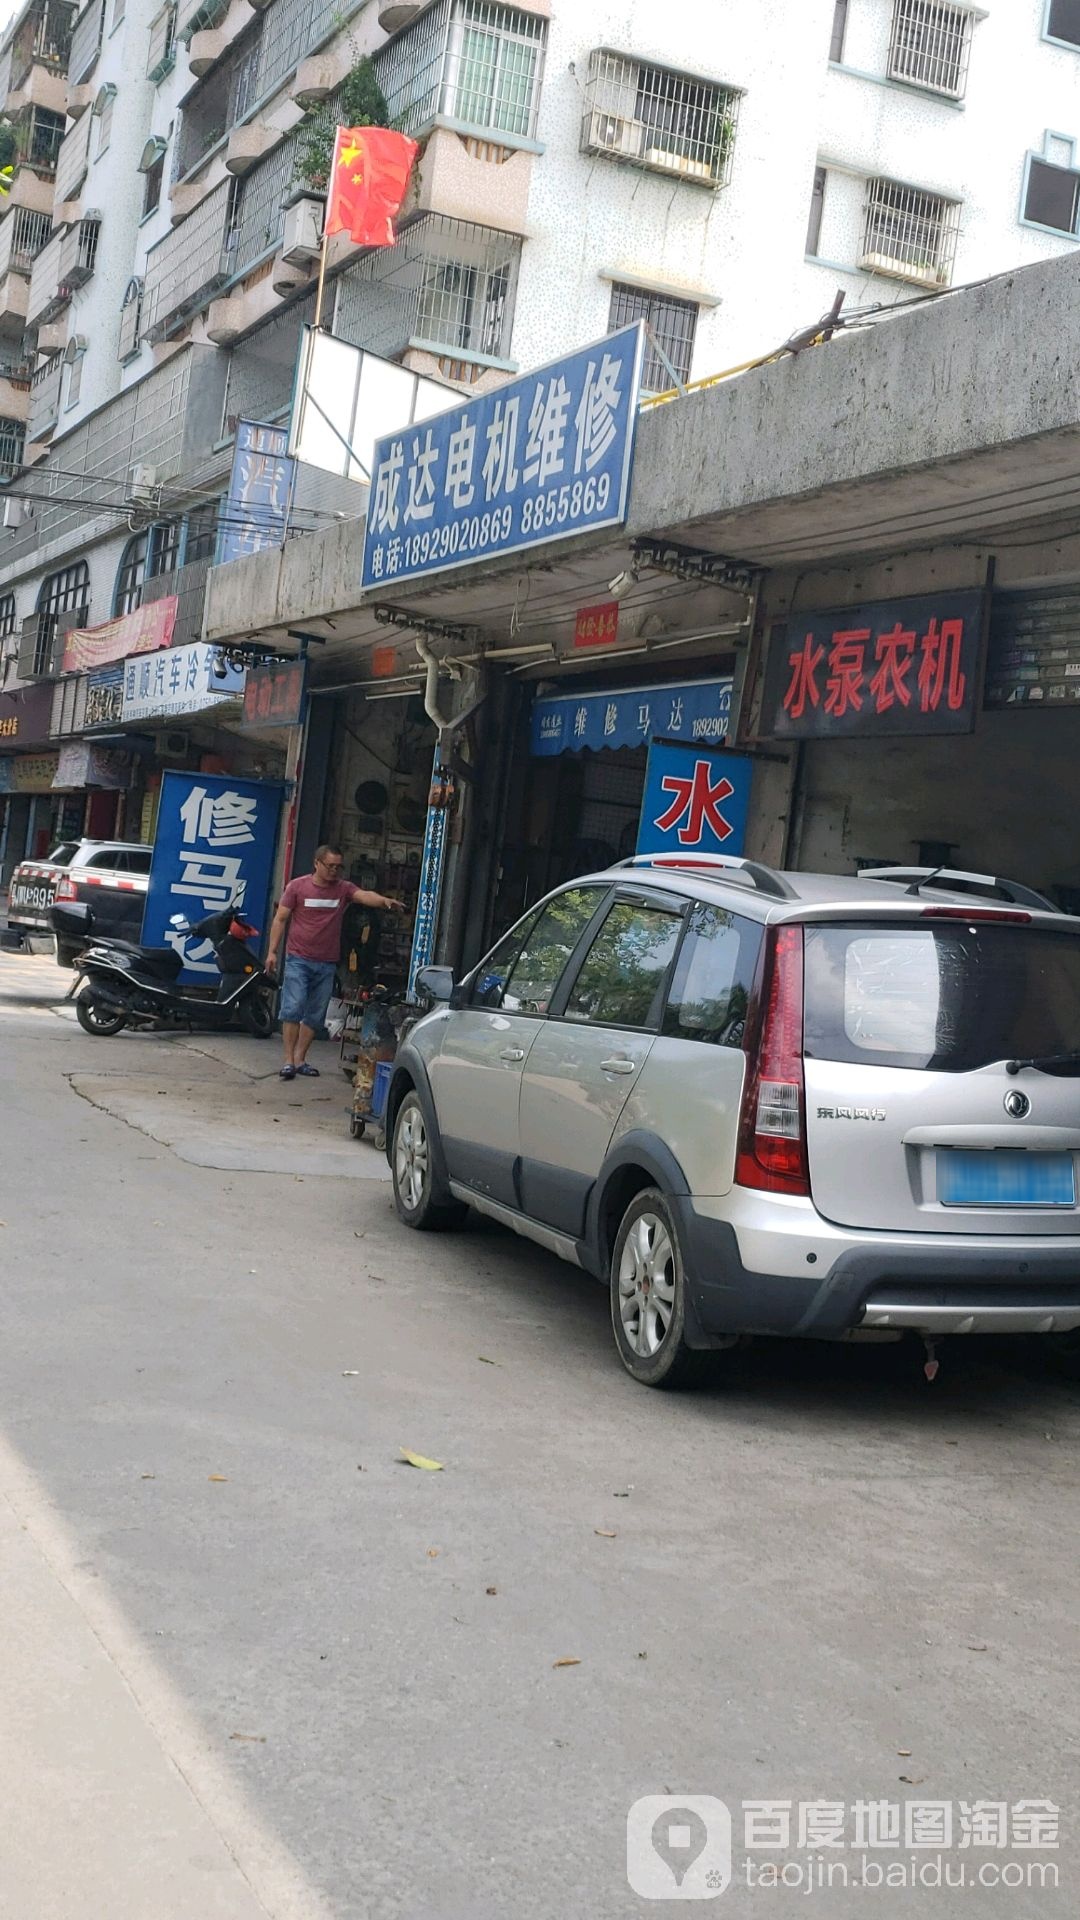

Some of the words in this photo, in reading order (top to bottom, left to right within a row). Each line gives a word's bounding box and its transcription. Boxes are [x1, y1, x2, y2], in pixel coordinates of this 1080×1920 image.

[369, 353, 623, 535] 成达电机维修
[370, 507, 512, 577] 电话:18929020869
[520, 472, 610, 535] 8855869
[573, 697, 684, 737] 维修马达
[783, 617, 965, 718] 水泵农机
[653, 759, 735, 868] 水
[817, 1106, 887, 1122] 东风风行
